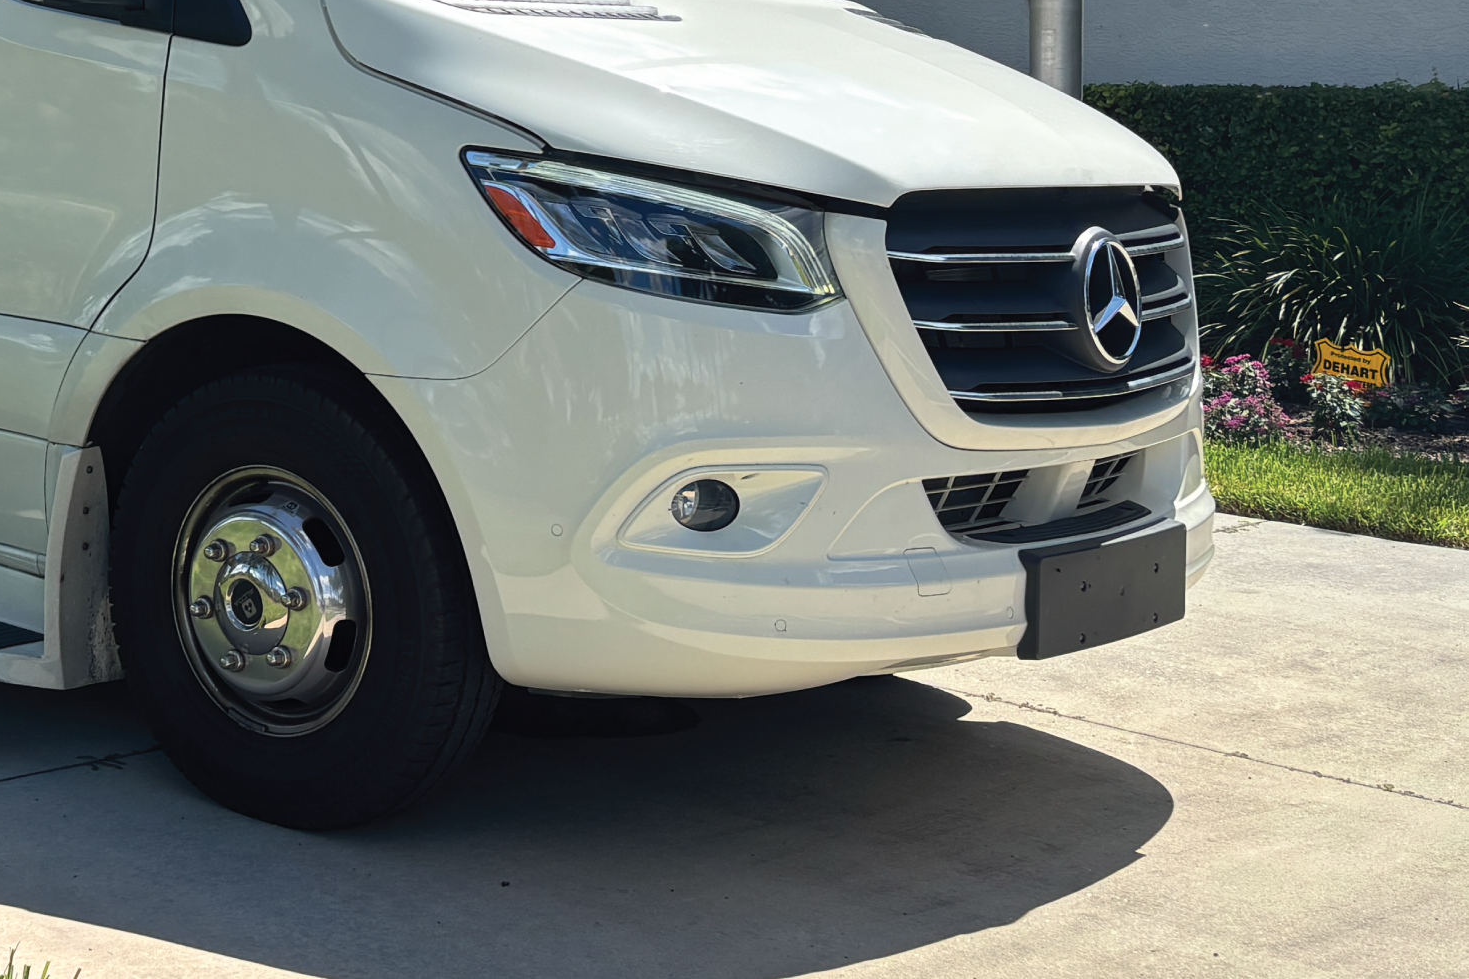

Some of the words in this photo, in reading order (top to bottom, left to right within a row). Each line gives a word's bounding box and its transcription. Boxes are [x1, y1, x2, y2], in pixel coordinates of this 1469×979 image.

[1331, 351, 1361, 363] Protected
[1363, 357, 1371, 365] by
[1323, 359, 1378, 379] DEHART
[234, 588, 254, 606] ALCOA
